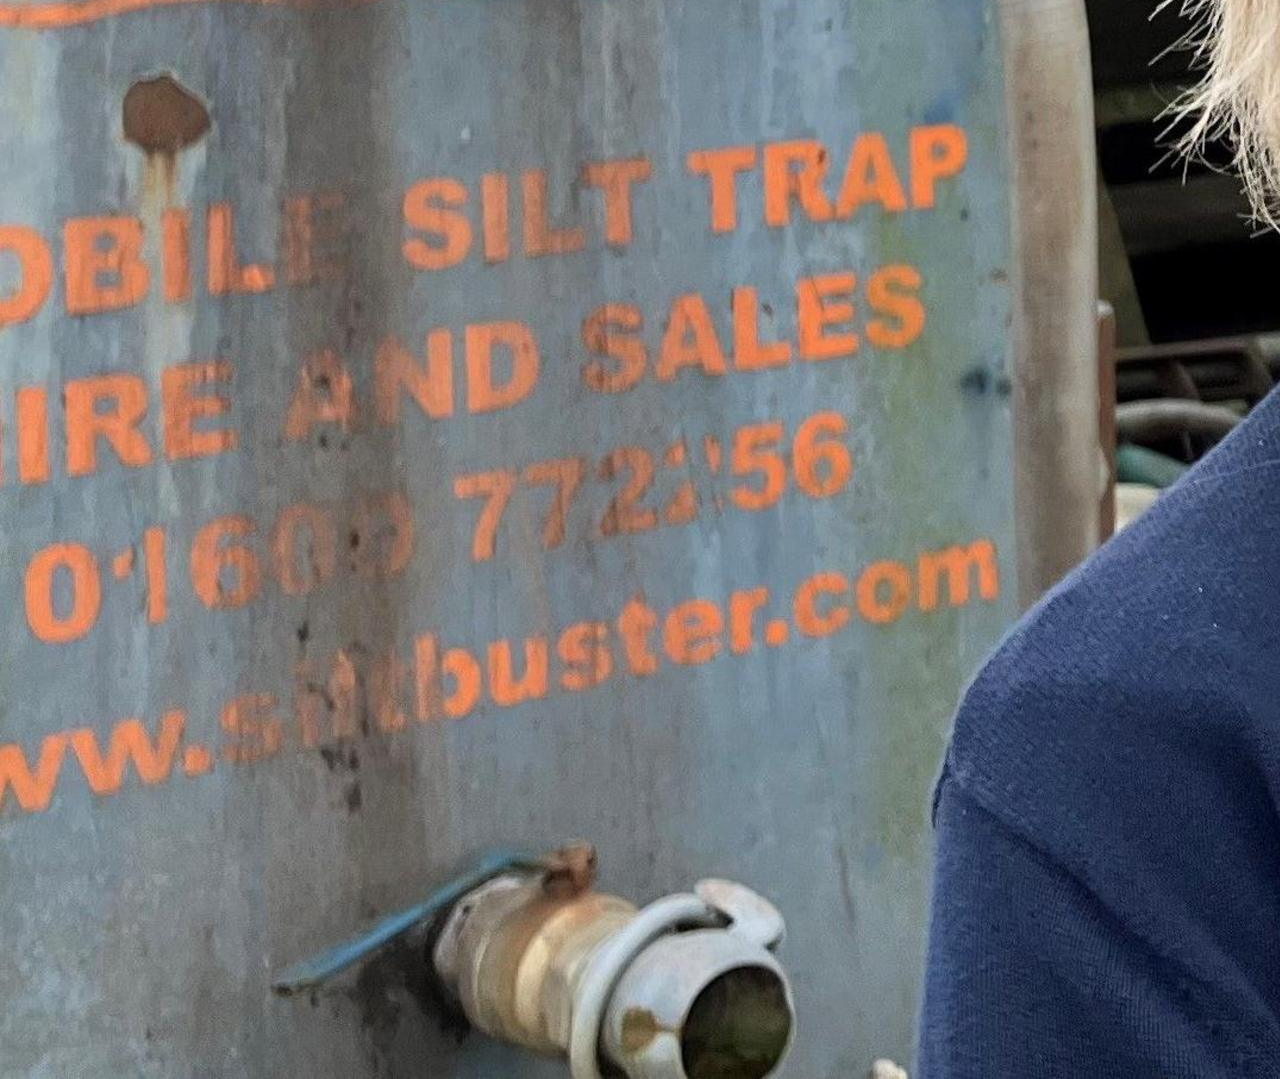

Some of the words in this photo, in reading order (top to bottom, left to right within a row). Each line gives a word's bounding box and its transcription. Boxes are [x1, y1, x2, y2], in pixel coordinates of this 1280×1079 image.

[401, 157, 653, 273] SILT
[687, 124, 969, 233] TRAP
[0, 358, 239, 488] IRE
[284, 320, 541, 444] AND
[581, 264, 926, 396] SALES
